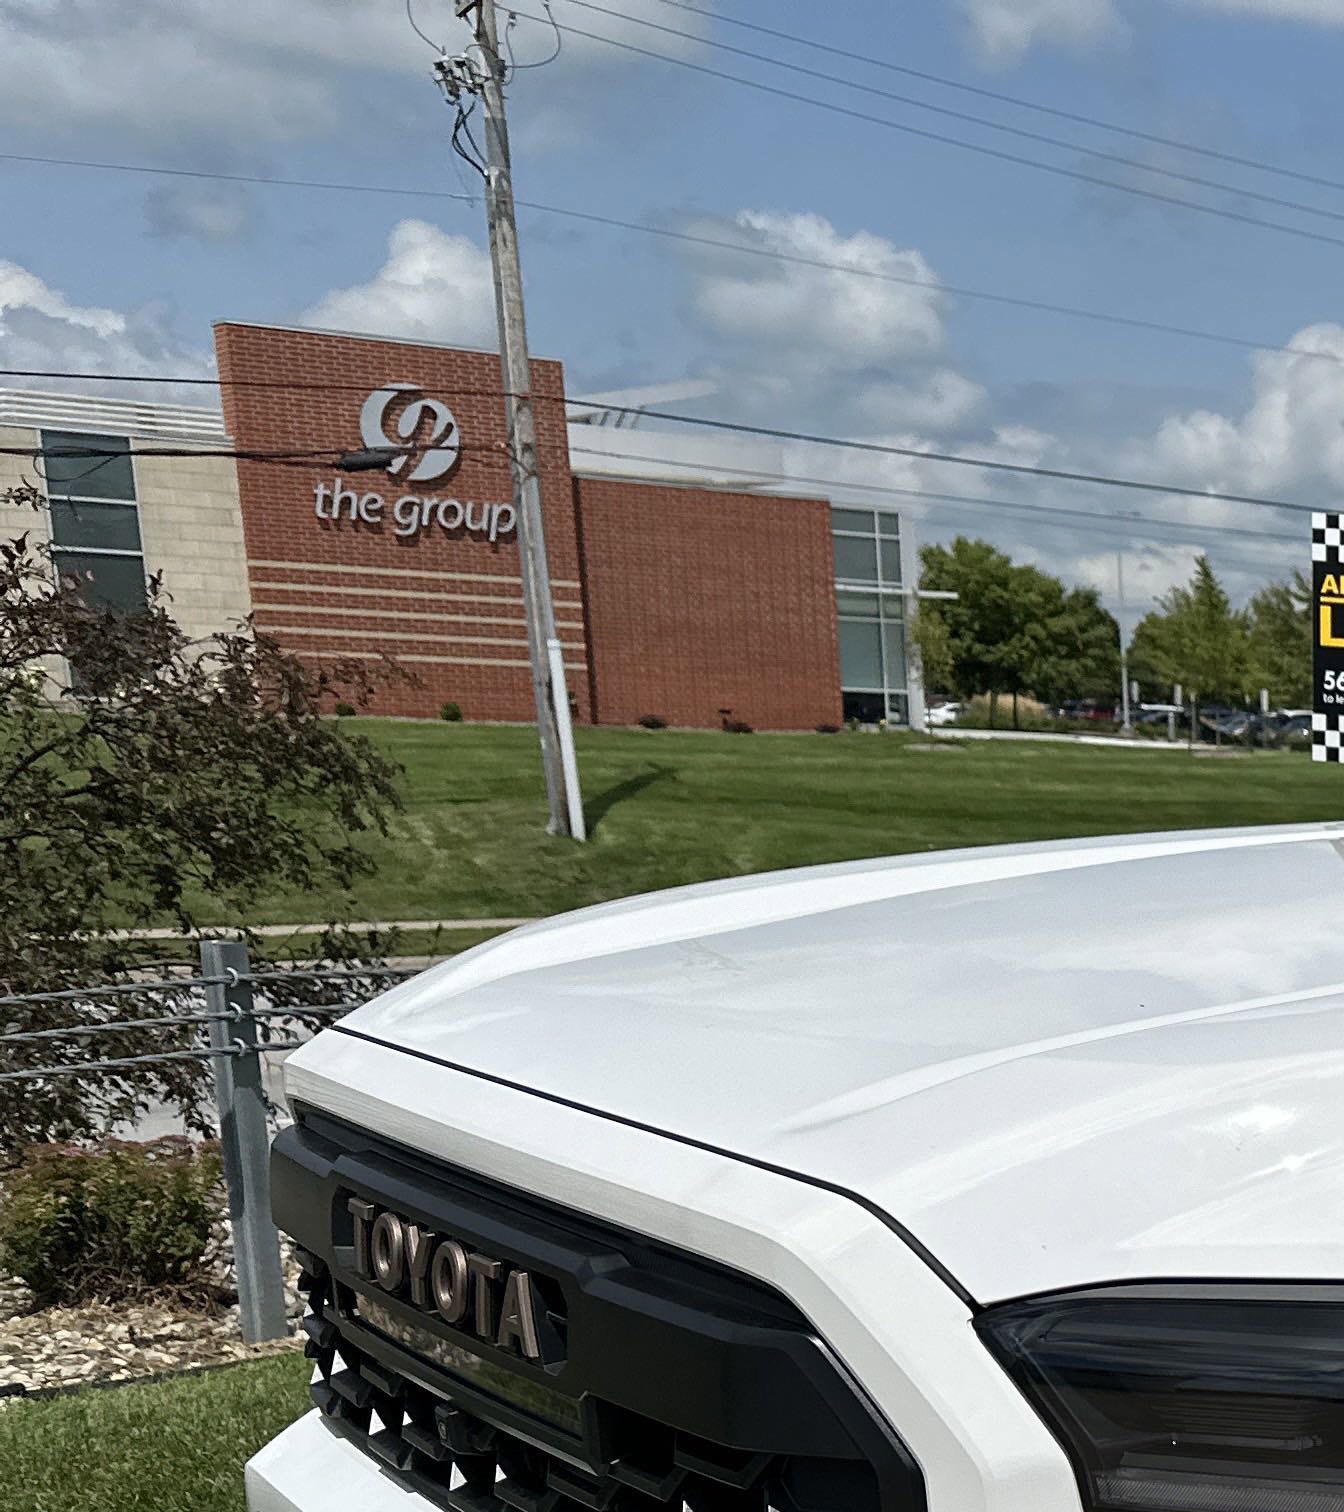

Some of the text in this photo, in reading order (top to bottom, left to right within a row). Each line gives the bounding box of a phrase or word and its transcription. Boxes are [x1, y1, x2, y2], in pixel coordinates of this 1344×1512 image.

[313, 477, 517, 543] the group
[1322, 693, 1335, 704] to
[348, 1196, 541, 1359] TOYOTA
